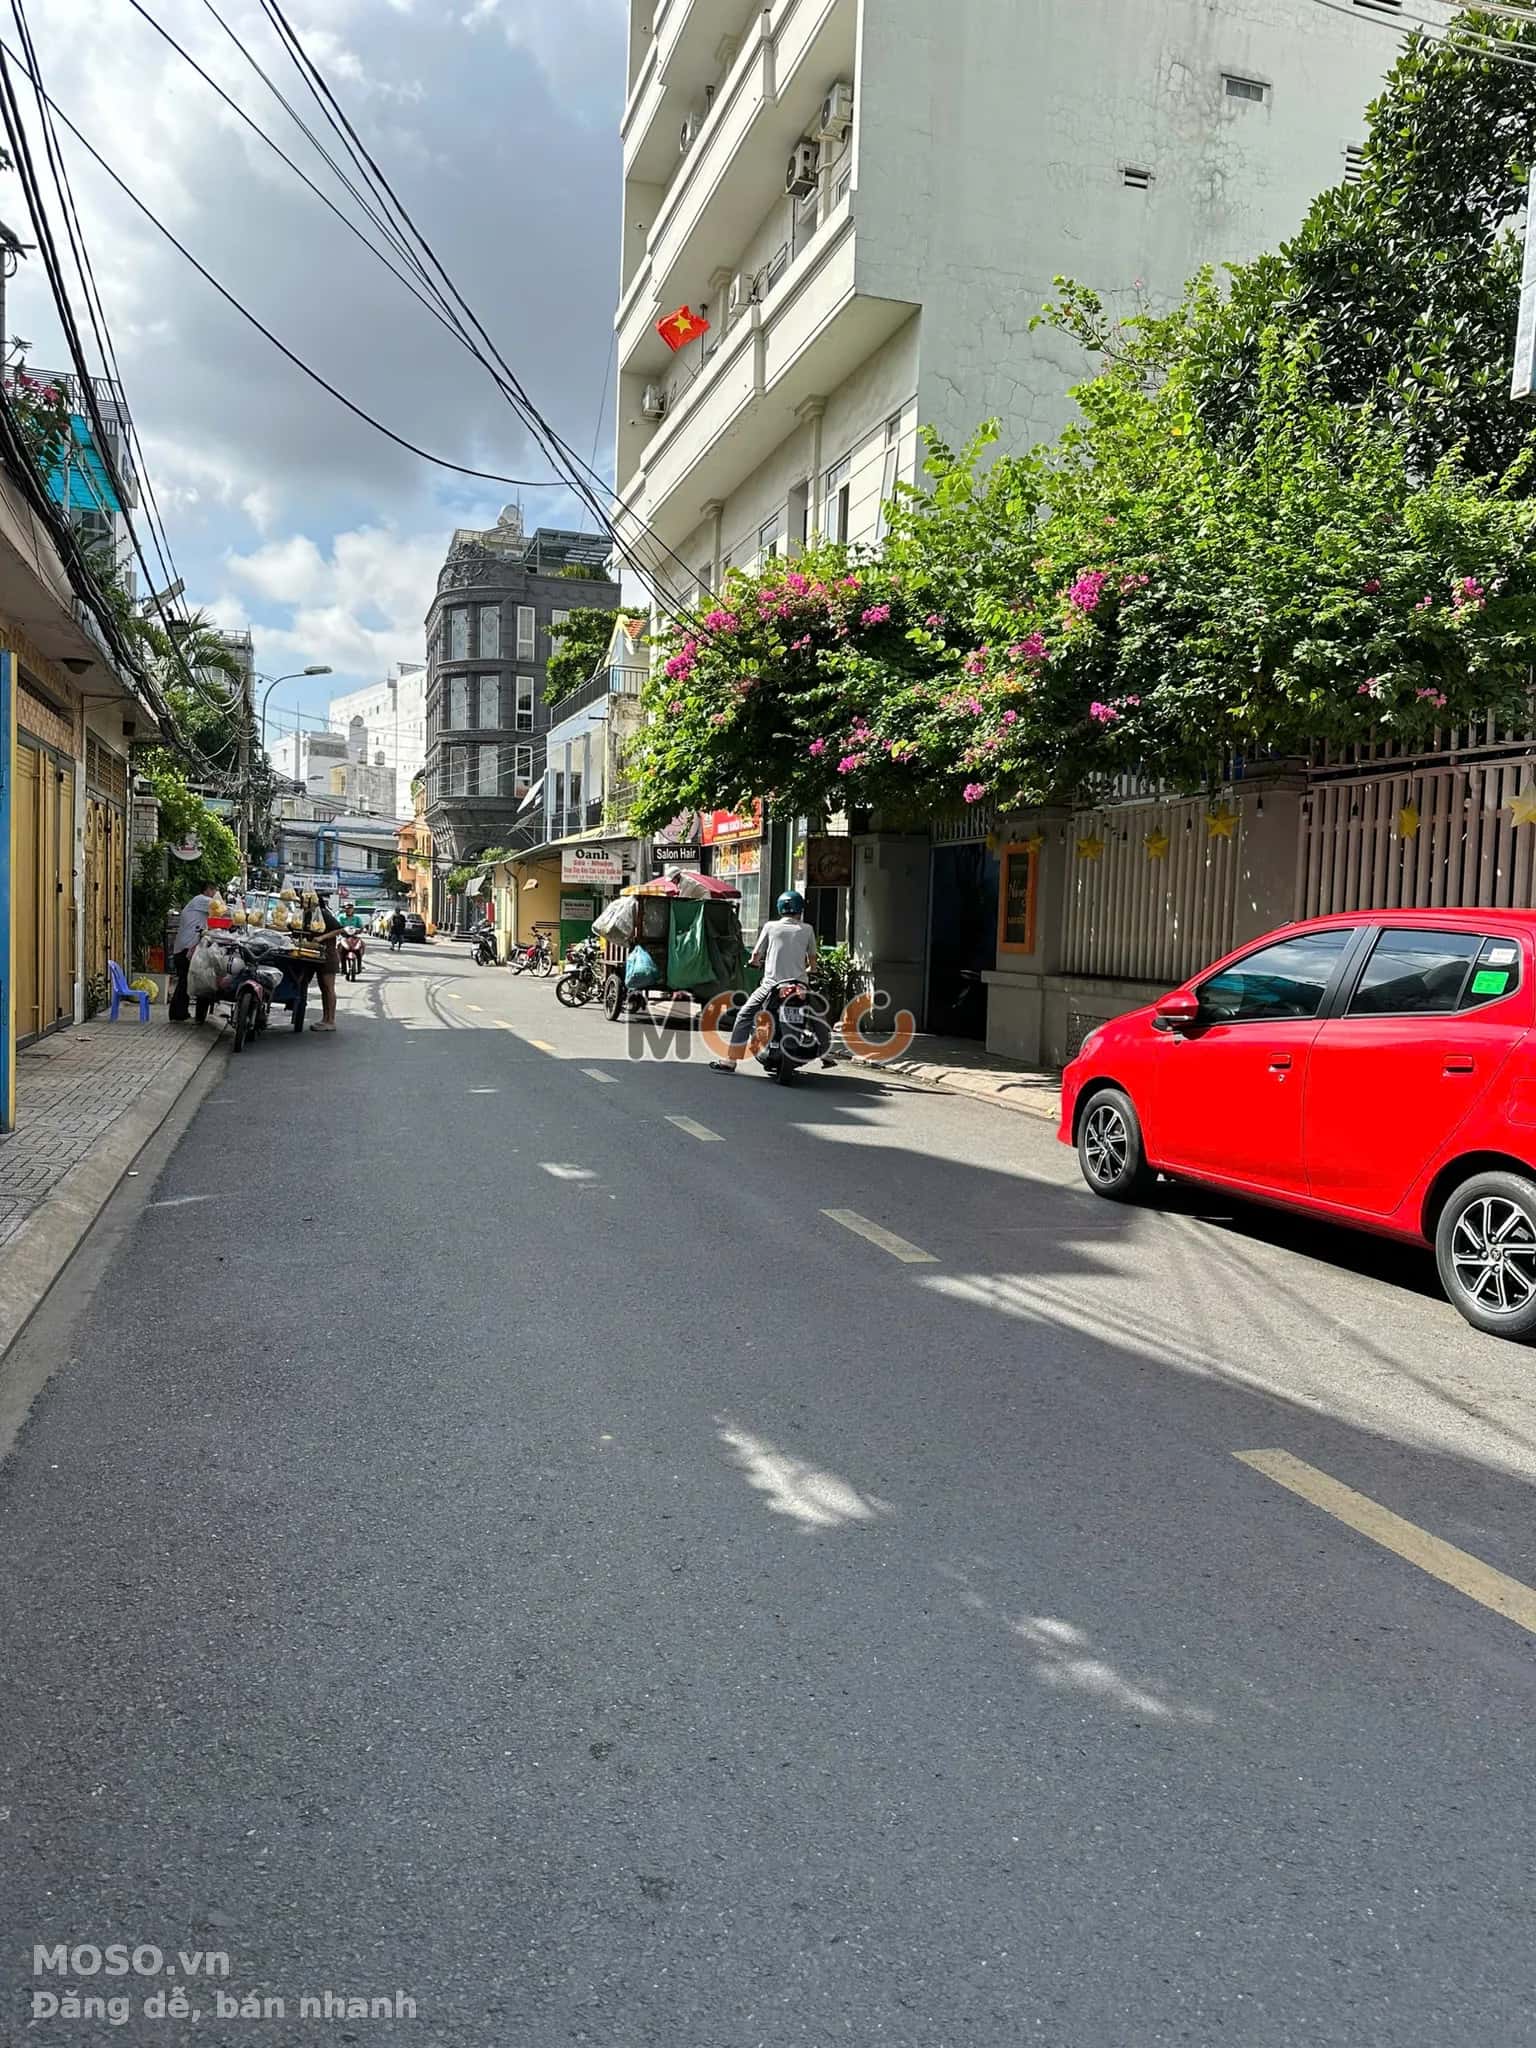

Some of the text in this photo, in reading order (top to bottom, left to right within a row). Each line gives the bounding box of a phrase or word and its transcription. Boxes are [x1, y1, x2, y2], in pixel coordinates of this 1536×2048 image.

[575, 848, 609, 860] Oanh
[656, 847, 697, 860] Salon Hair
